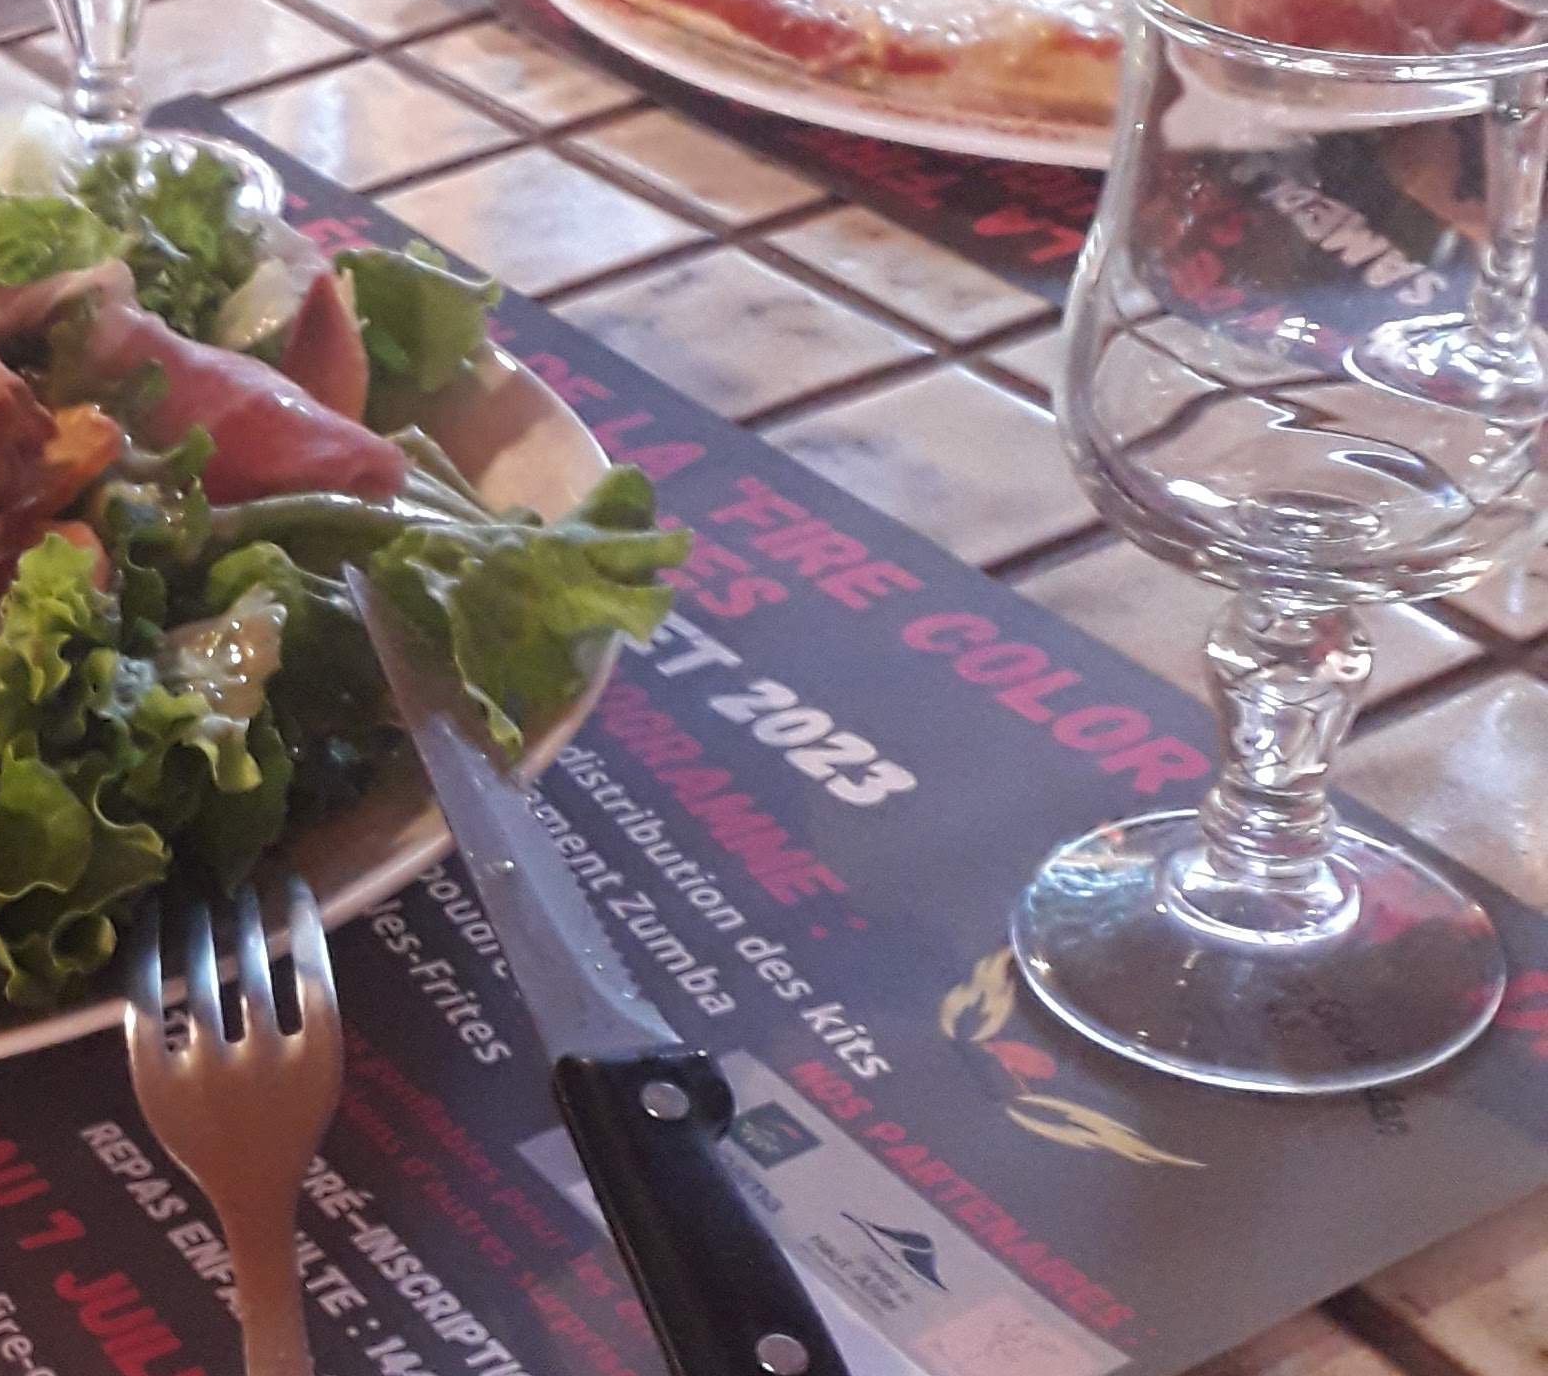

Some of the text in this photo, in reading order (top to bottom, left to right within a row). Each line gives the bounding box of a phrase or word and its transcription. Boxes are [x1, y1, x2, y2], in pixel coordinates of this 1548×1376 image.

[709, 476, 924, 612] FIRE
[902, 610, 1212, 794] COLOR
[707, 677, 918, 808] 2023
[606, 889, 738, 1018] Zumba
[734, 934, 814, 1001] des
[801, 1001, 892, 1080] kits
[80, 1121, 187, 1222] REPAS
